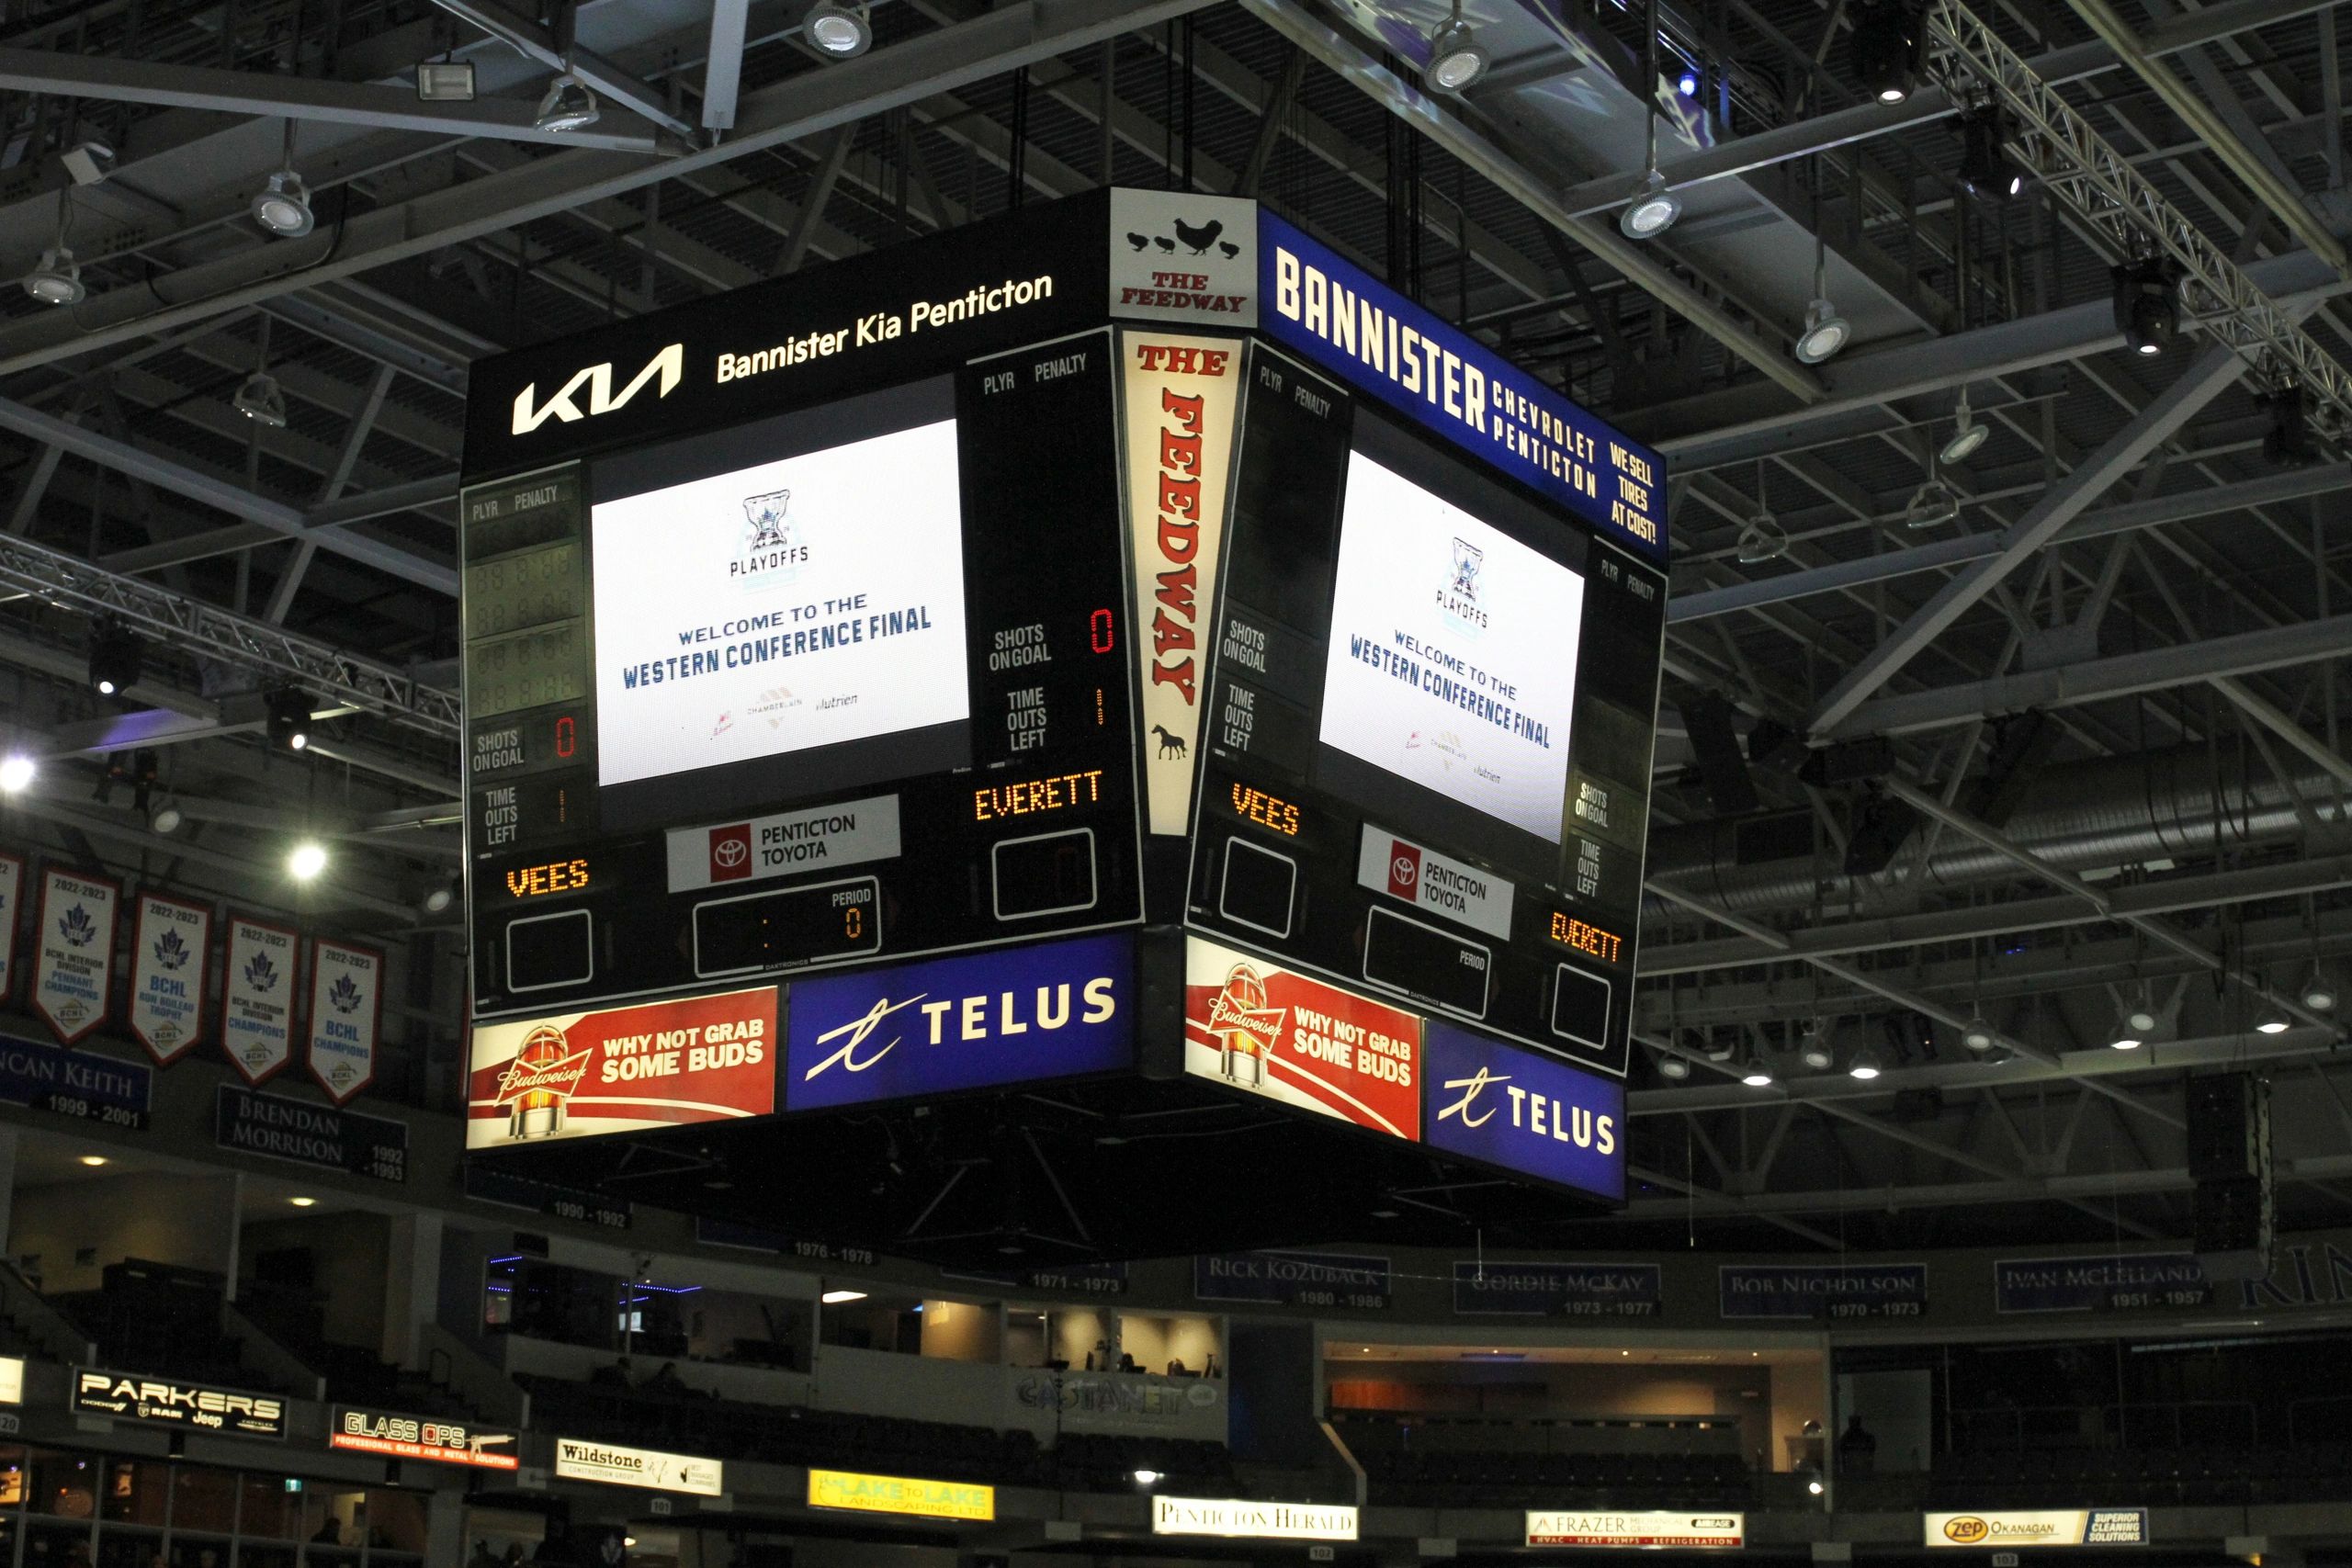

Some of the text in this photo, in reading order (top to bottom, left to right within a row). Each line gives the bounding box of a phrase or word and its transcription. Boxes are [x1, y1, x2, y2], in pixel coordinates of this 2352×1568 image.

[1152, 272, 1209, 291] THE
[1121, 287, 1248, 313] FEEDWAY
[717, 276, 1053, 384] Bannister Kia Penticton
[1277, 246, 1486, 434] BANNISTER
[984, 352, 1088, 395] PLYR PENALTY
[1137, 344, 1229, 378] THE
[512, 344, 684, 435] KIA
[1260, 365, 1331, 422] PLYR PENALTY
[1492, 379, 1596, 466] CHEVROLET
[1494, 422, 1597, 500] PENTICTON
[1610, 441, 1655, 489] WE SELL
[472, 486, 558, 519] PLYR PENALTY
[1619, 476, 1649, 513] TIRES
[1611, 503, 1657, 546] AT COST!
[1150, 388, 1204, 706] FEEDWAY
[729, 546, 809, 578] PLAYOFFS
[1601, 558, 1655, 604] PLYR PENALTY
[678, 592, 868, 646] WELCOME TO THE
[1436, 589, 1488, 630] PLAYOFFS
[994, 624, 1045, 649] SHOTS
[1091, 608, 1114, 654] 0
[1229, 619, 1265, 652] SHOTS
[623, 604, 932, 690] WESTERN CONFERENCE FINAL
[1395, 628, 1518, 703] WELCOME TO THE
[1008, 687, 1045, 708] TIME
[1228, 683, 1254, 712] TIME
[1351, 632, 1420, 688] WESTERN
[1422, 668, 1511, 731] CONFERENCE
[1512, 710, 1550, 750] FINAL
[1007, 707, 1047, 732] OUTS
[1224, 703, 1253, 733] OUTS
[477, 730, 518, 750] SHOTS
[556, 716, 576, 758] 0
[1011, 728, 1046, 751] LEFT
[1223, 724, 1250, 752] LEFT
[485, 787, 516, 807] TIME
[976, 770, 1102, 821] EVERETT
[1232, 781, 1299, 836] VEES
[1581, 782, 1608, 809] SHOTS
[485, 806, 518, 826] OUTS
[761, 813, 857, 846] PENTICTON
[488, 825, 516, 845] LEFT
[762, 840, 828, 867] TOYOTA
[1580, 838, 1600, 862] TIME
[507, 859, 590, 897] VEES
[1425, 861, 1487, 902] PENTICTON
[1577, 855, 1600, 881] OUTS
[55, 879, 106, 900] 2022-2023
[831, 888, 871, 908] PERIOD
[1423, 882, 1467, 915] TOYOTA
[1577, 874, 1598, 898] LEFT
[150, 903, 198, 925] 2022-2023
[844, 908, 862, 939] 0
[241, 927, 287, 948] 2022-2023
[1552, 911, 1622, 963] EVERETT
[45, 948, 104, 970] BCHL INTERIOR
[57, 960, 91, 976] DIVISION
[325, 949, 370, 970] 2022-2023
[1459, 949, 1486, 972] PERIOD
[45, 980, 98, 1000] CHAMPIONS
[52, 971, 95, 988] PENNANT
[150, 976, 187, 998] BCHL
[922, 977, 1116, 1045] TELUS
[1207, 998, 1283, 1037] Budweiser
[228, 1017, 286, 1039] CHAMPIONS
[325, 1020, 359, 1042] BCHL
[603, 1019, 764, 1058] WHY NOT GRAB
[1294, 1005, 1411, 1062] WHY NOT GRAB
[313, 1037, 368, 1059] CHAMPIONS
[1294, 1027, 1411, 1088] SOME BUDS
[601, 1040, 763, 1084] SOME BUDS
[64, 1063, 133, 1100] KEITH
[496, 1066, 587, 1092] Budweiser
[49, 1094, 140, 1129] 1999 2001
[238, 1096, 341, 1136] BRENDAN
[1507, 1085, 1615, 1156] TELUS
[233, 1122, 344, 1164] MORRISON
[372, 1145, 403, 1162] 1992
[372, 1161, 403, 1181] 1993
[553, 1201, 626, 1228] 1990 1992
[794, 1240, 873, 1266] 1976 1978
[1032, 1273, 1119, 1292] 1971 1973
[1209, 1257, 1380, 1287] RICK KOZUBACK
[1471, 1272, 1561, 1292] GORDIE
[1732, 1275, 1916, 1294] BOB NICHOLSON
[2006, 1269, 2057, 1290] IVAN
[1300, 1291, 1384, 1309] 1980 1986
[1564, 1302, 1654, 1314] 1973 1977
[1831, 1302, 1919, 1316] 1970 1973
[2111, 1290, 2205, 1307] 1951 1957
[81, 1373, 281, 1419] PARKERS
[1016, 1378, 1183, 1415] CASTANET
[151, 1406, 223, 1429] RAM Jeep
[345, 1412, 465, 1449] GLASS OPS
[334, 1435, 515, 1466] PROFESSIONAL GLASS AND METAL SOLUTIONS
[562, 1444, 642, 1469] Wildstone
[569, 1466, 614, 1478] CONSTRUCTION
[841, 1478, 986, 1507] LAKE TO LAKE
[840, 1496, 986, 1517] LANDSCAPING LTD
[1161, 1503, 1351, 1530] PENTICTON HERALD
[2094, 1513, 2140, 1523] SUPERIOR
[1556, 1517, 1626, 1533] FRAZER
[1991, 1521, 2055, 1534] OKANAGAN
[2088, 1532, 2141, 1542] SOLUTIONS
[2091, 1523, 2140, 1532] CLEANING
